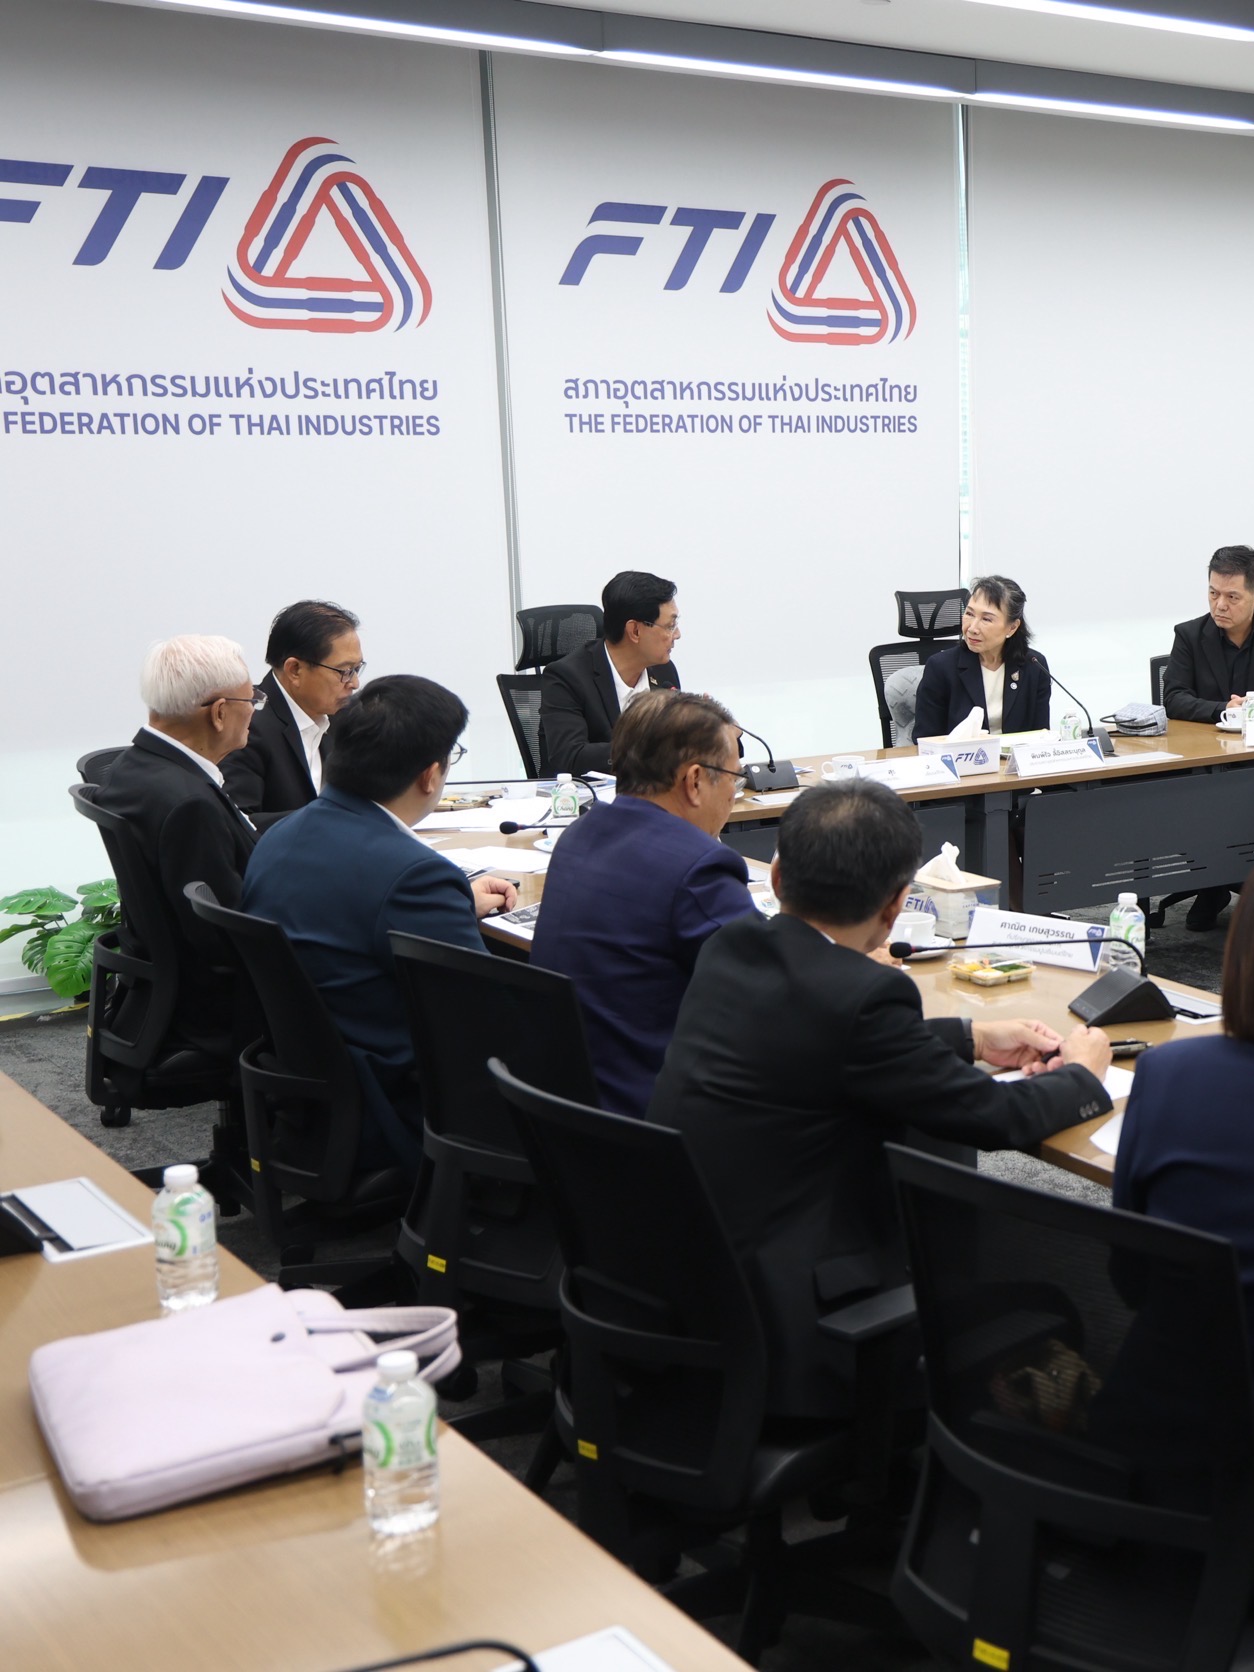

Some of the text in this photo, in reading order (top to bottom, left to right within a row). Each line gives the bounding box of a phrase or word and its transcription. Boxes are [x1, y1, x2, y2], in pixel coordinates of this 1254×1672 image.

[558, 202, 777, 294] FTI
[0, 368, 439, 405] อุตสาหกรรมแห่งประเทศไทย
[563, 376, 918, 408] สภาอุตสาหกรรมแห่งประเทศไทย
[4, 412, 440, 436] FEDERATION OF THAI INDUSTRIES
[565, 413, 918, 433] THE FEDERATION OF THAI INDUSTRIES
[955, 752, 975, 763] FTI
[905, 896, 925, 911] FTI
